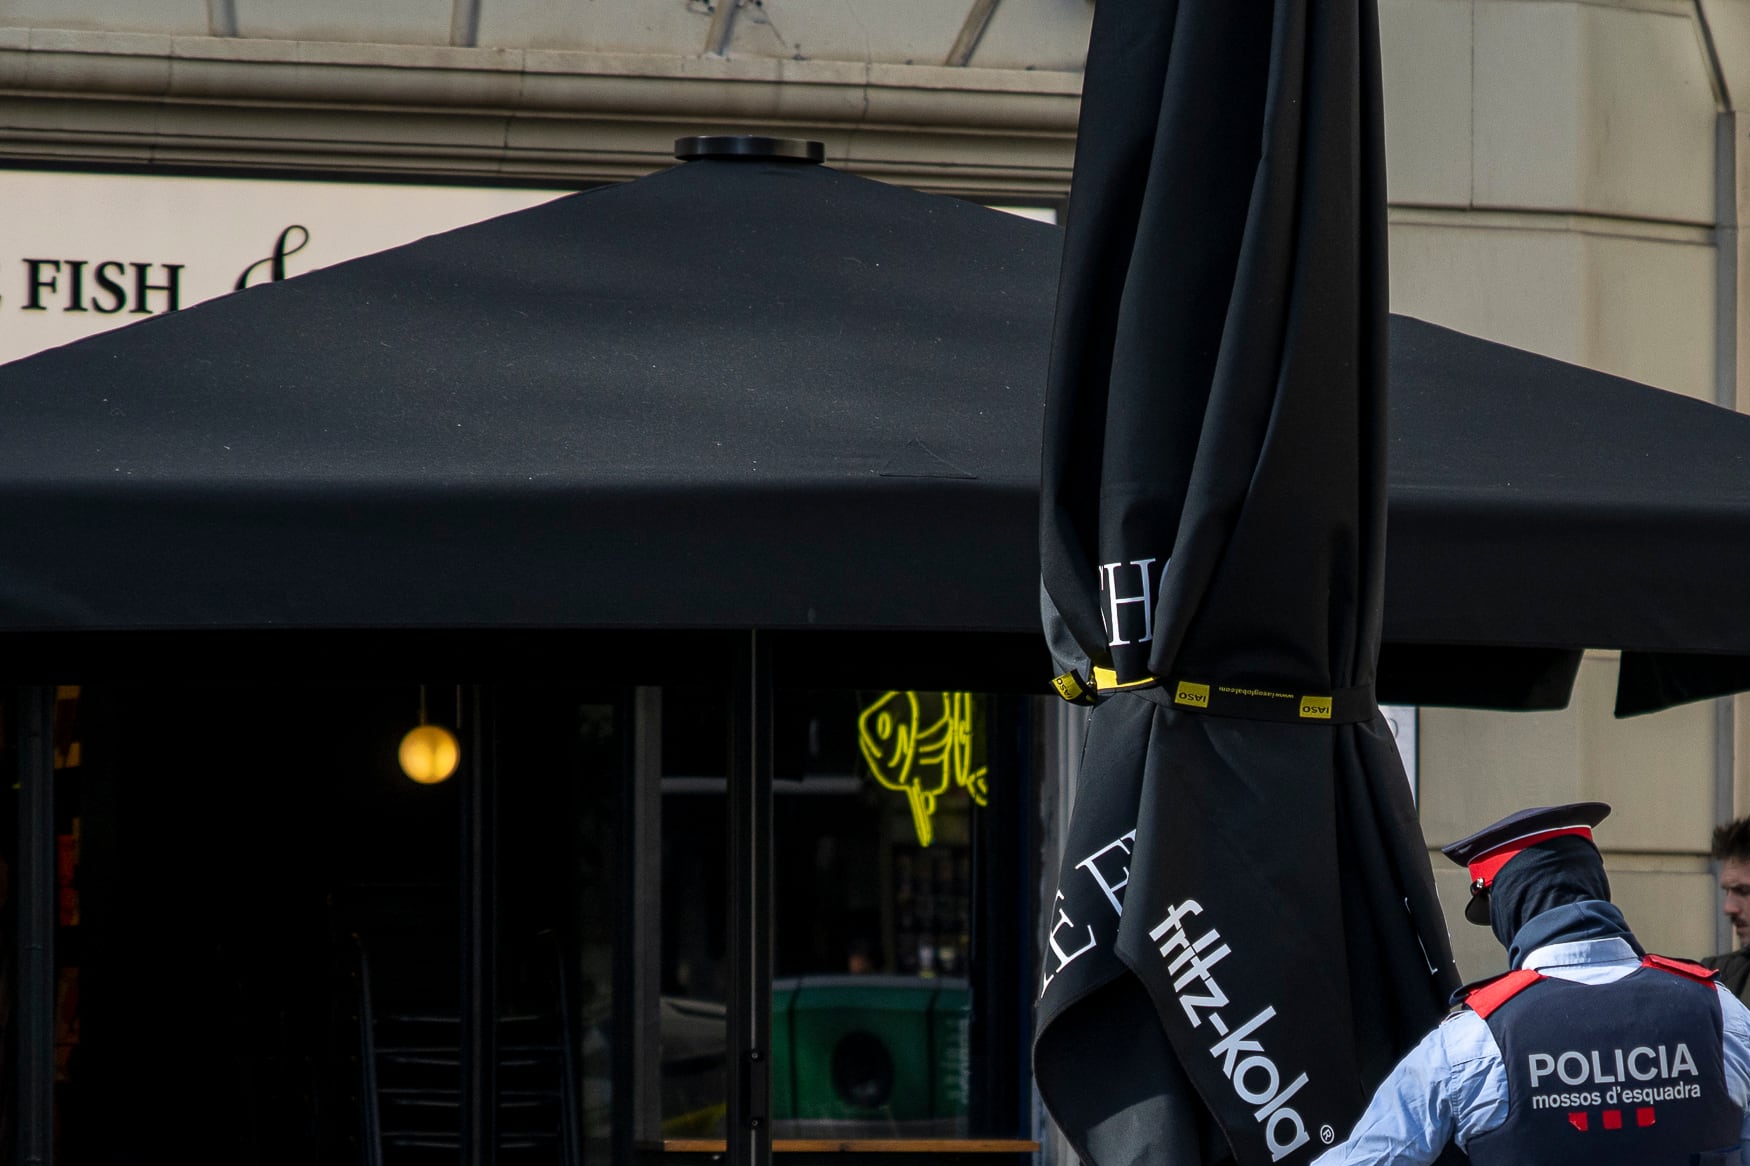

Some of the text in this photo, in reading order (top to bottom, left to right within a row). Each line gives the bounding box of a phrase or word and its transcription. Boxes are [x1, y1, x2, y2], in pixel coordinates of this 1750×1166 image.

[21, 257, 186, 314] FISH
[1178, 692, 1207, 703] IASO
[1302, 706, 1329, 714] IASO
[1148, 899, 1311, 1163] fritz-kola
[1528, 1043, 1699, 1088] POLICIA
[1532, 1091, 1602, 1110] mossos
